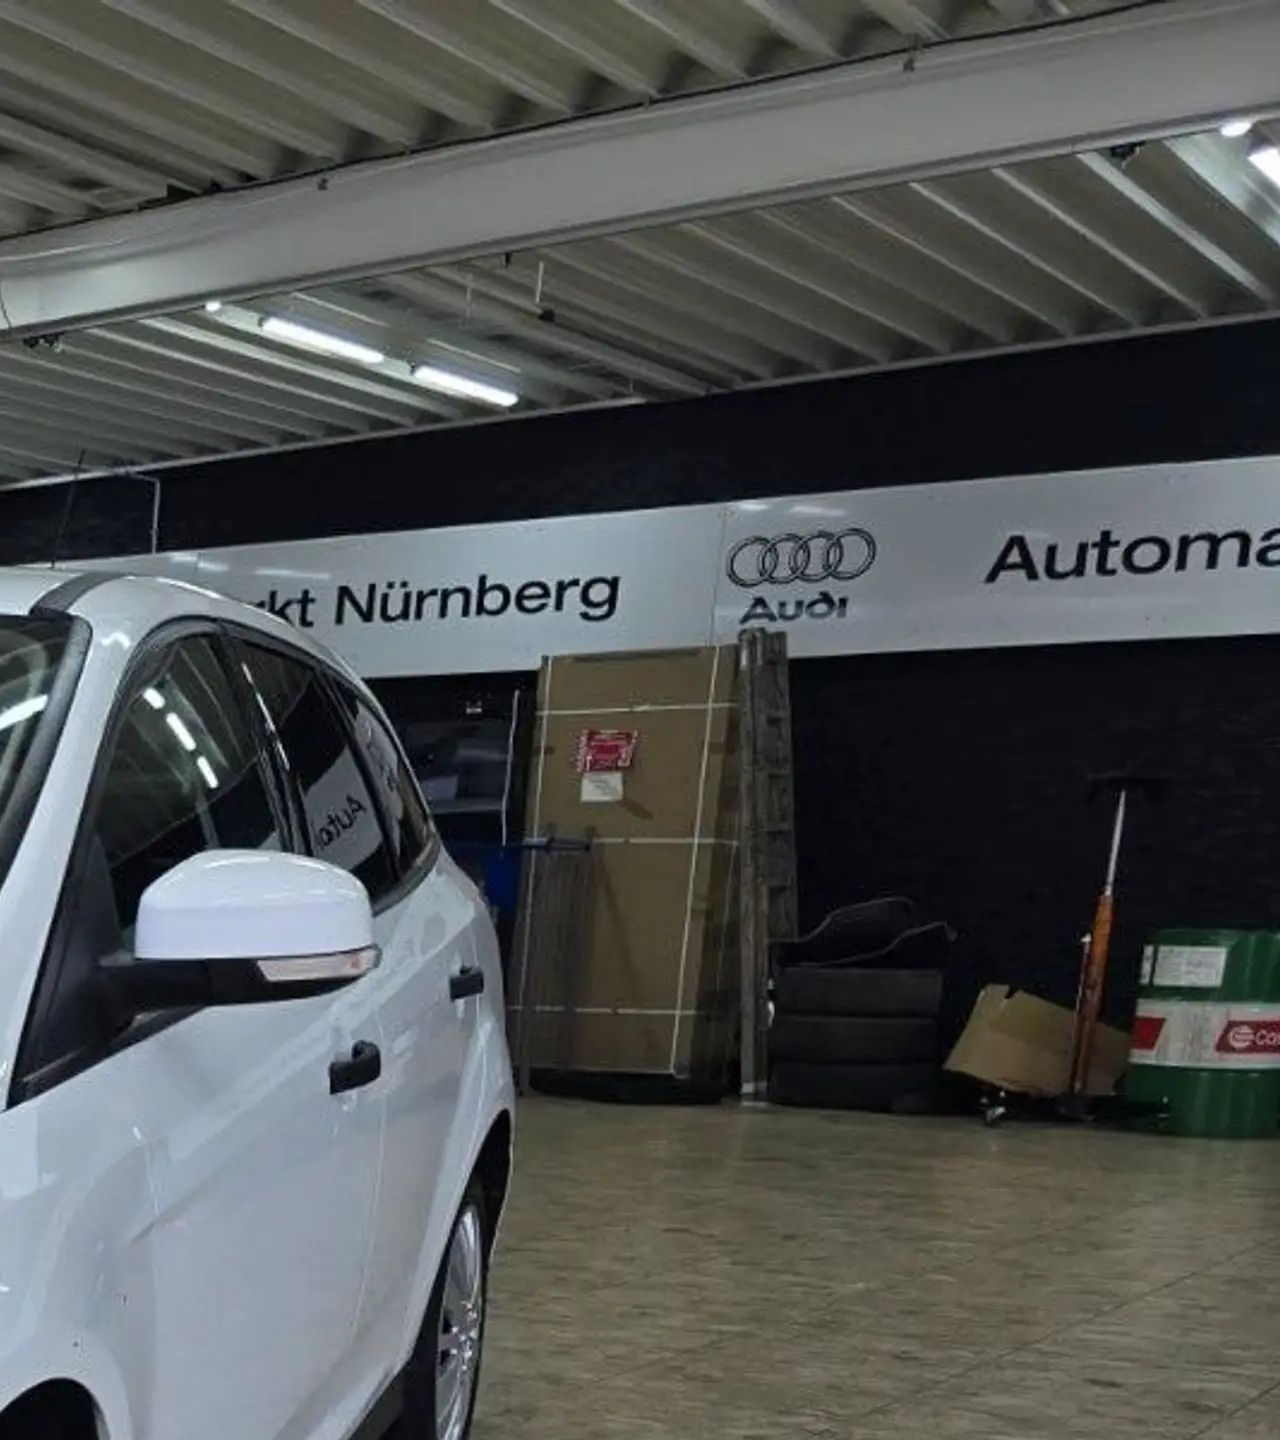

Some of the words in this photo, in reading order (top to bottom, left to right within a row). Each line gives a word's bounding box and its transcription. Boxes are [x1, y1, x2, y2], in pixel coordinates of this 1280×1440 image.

[253, 589, 316, 629] kt
[334, 574, 620, 626] Nürnberg
[739, 591, 849, 625] Audi
